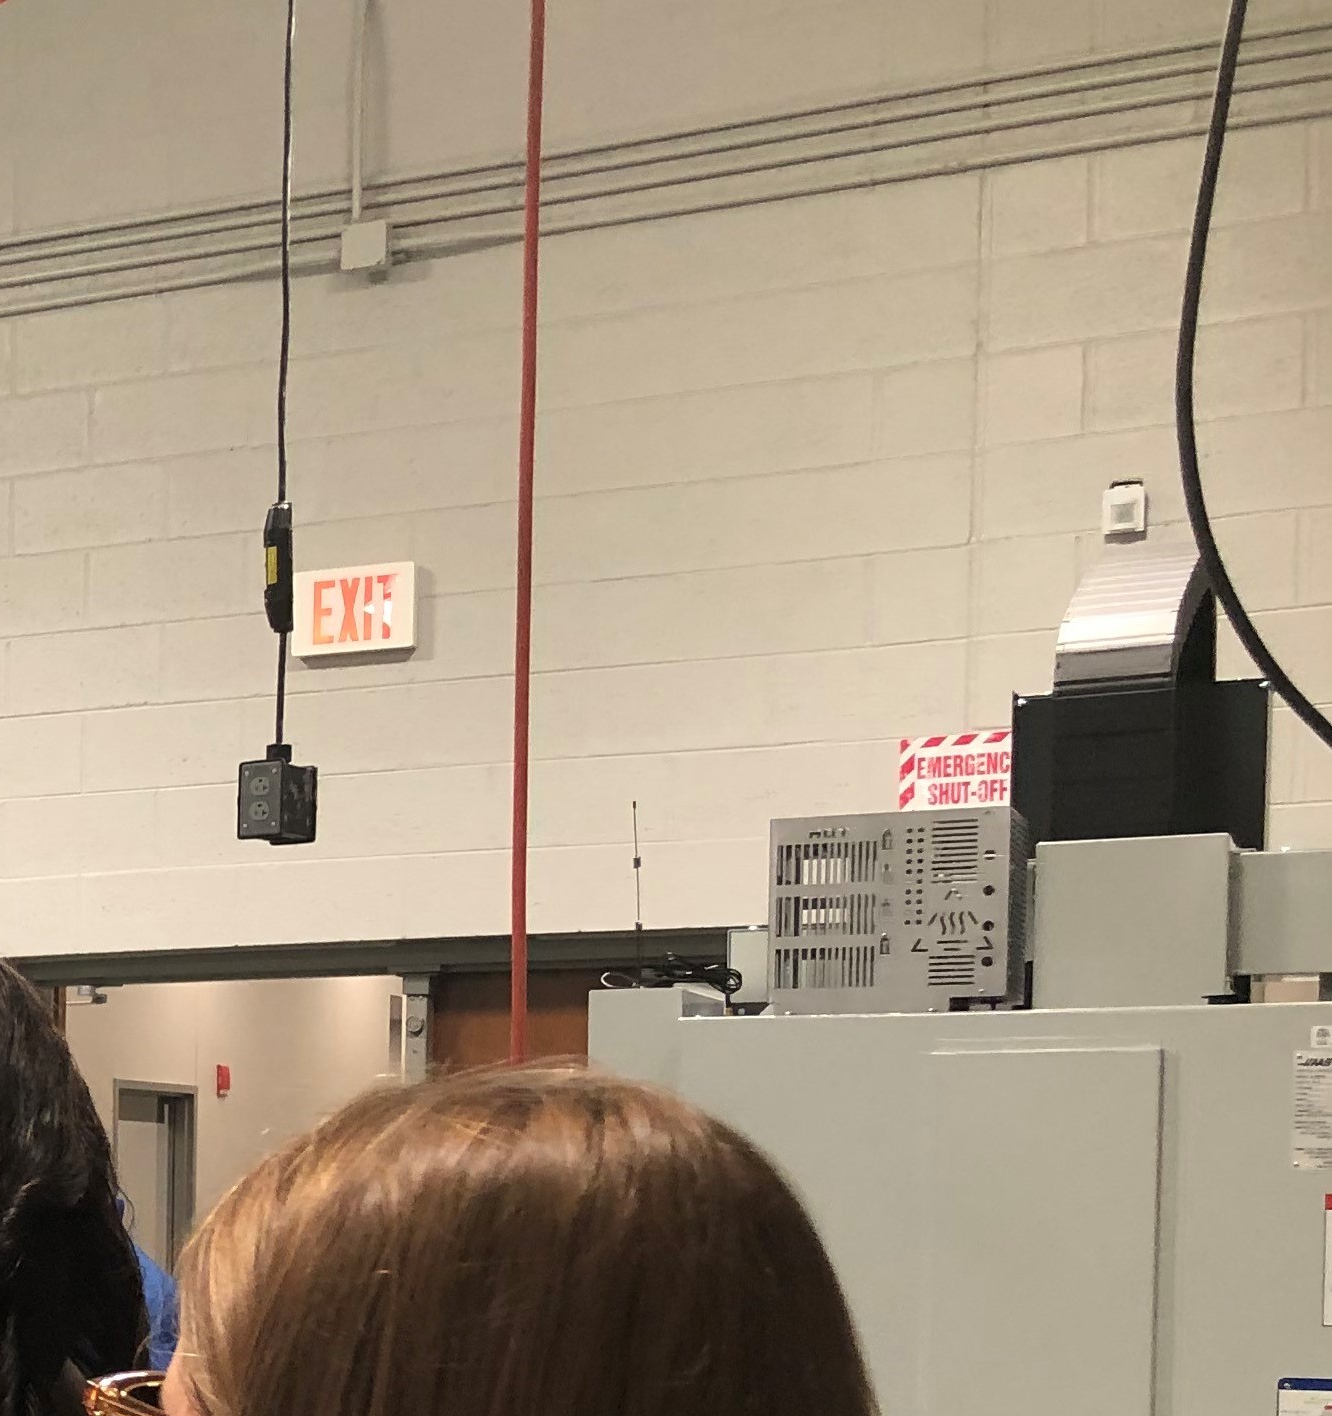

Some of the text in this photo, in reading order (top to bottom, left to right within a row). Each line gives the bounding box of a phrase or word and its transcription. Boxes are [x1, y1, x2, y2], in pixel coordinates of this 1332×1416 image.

[312, 573, 399, 646] EXIT
[916, 751, 1011, 779] EMERGENC
[927, 779, 1009, 806] SHUT-OFF
